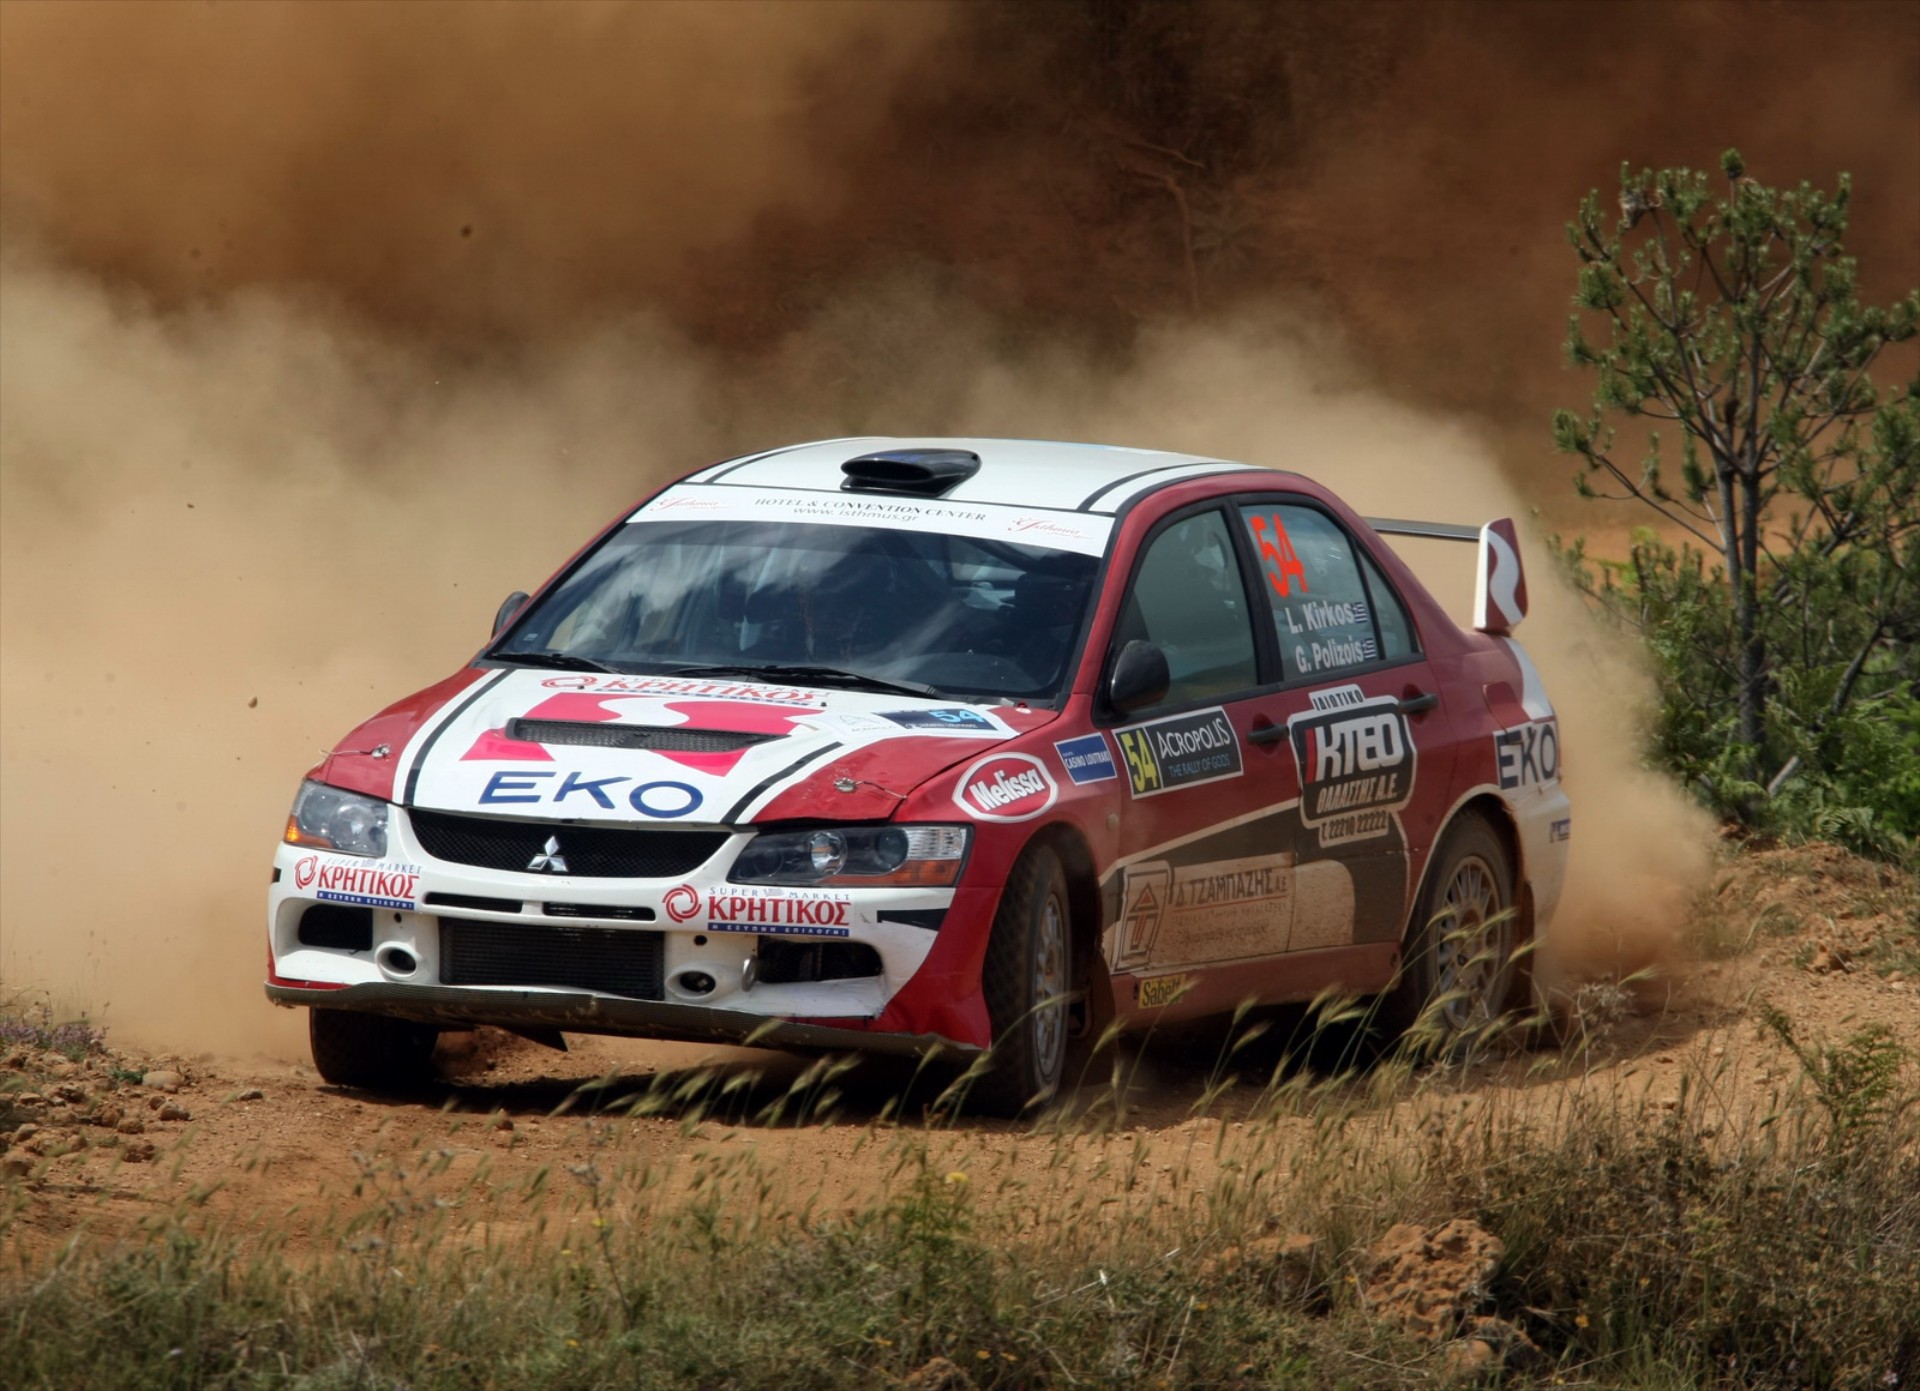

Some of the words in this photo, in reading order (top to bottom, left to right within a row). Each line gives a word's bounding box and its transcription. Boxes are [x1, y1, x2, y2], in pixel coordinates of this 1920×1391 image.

[754, 498, 802, 507] HOTEL
[822, 501, 920, 514] CONVENTION
[925, 508, 987, 521] CENTER
[1250, 513, 1309, 598] 54
[1285, 607, 1303, 634] L.
[1302, 600, 1355, 631] Kirkos
[1295, 645, 1312, 673] G.
[1311, 635, 1364, 670] Polizois
[602, 680, 816, 702] ΚΡΗΤΙΚΟΣ
[1312, 689, 1364, 711] ΙΔΙΩΤΙΚΟ
[928, 709, 986, 723] 54
[1156, 717, 1231, 759] ACROPOLIS
[1065, 756, 1087, 769] CASINO
[1120, 729, 1158, 792] 54
[1168, 763, 1184, 778] THE
[1496, 723, 1556, 790] EKO
[478, 771, 704, 818] EKO
[969, 768, 1046, 811] Melissa
[1329, 813, 1355, 840] 22210
[1356, 810, 1387, 835] 22222
[317, 864, 420, 899] ΚΡΗΤΙΚΟΣ
[376, 863, 422, 875] MARKET
[708, 886, 759, 897] SUPER
[788, 890, 850, 900] MARKET
[707, 895, 852, 926] ΚΡΗΤΙΚΟΣ
